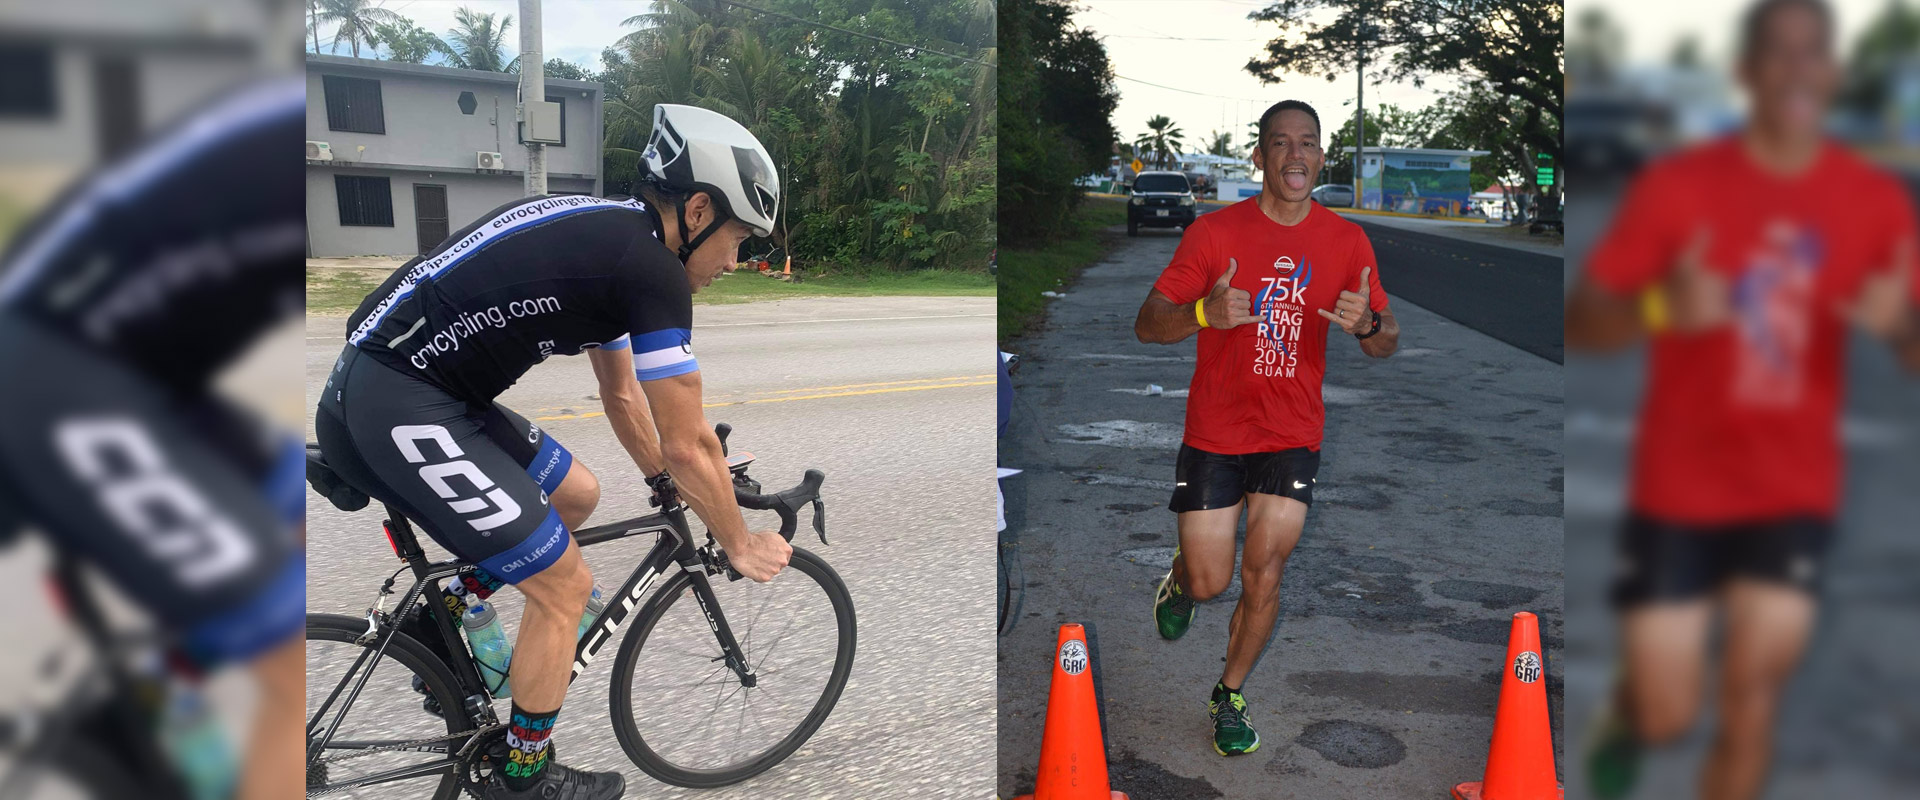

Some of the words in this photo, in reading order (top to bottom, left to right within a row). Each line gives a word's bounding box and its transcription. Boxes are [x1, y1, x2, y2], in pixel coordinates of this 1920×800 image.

[1260, 302, 1273, 310] 6TH
[1274, 302, 1304, 313] ANNUAL
[1256, 323, 1301, 342] RUN
[1254, 338, 1283, 352] JUNE
[1287, 342, 1298, 352] 13
[1254, 347, 1298, 367] 2015
[1253, 363, 1295, 378] GUAM
[535, 447, 561, 486] Lifestyle
[501, 558, 525, 573] CMI
[524, 523, 564, 563] Lifestyle
[1515, 665, 1540, 683] GRC
